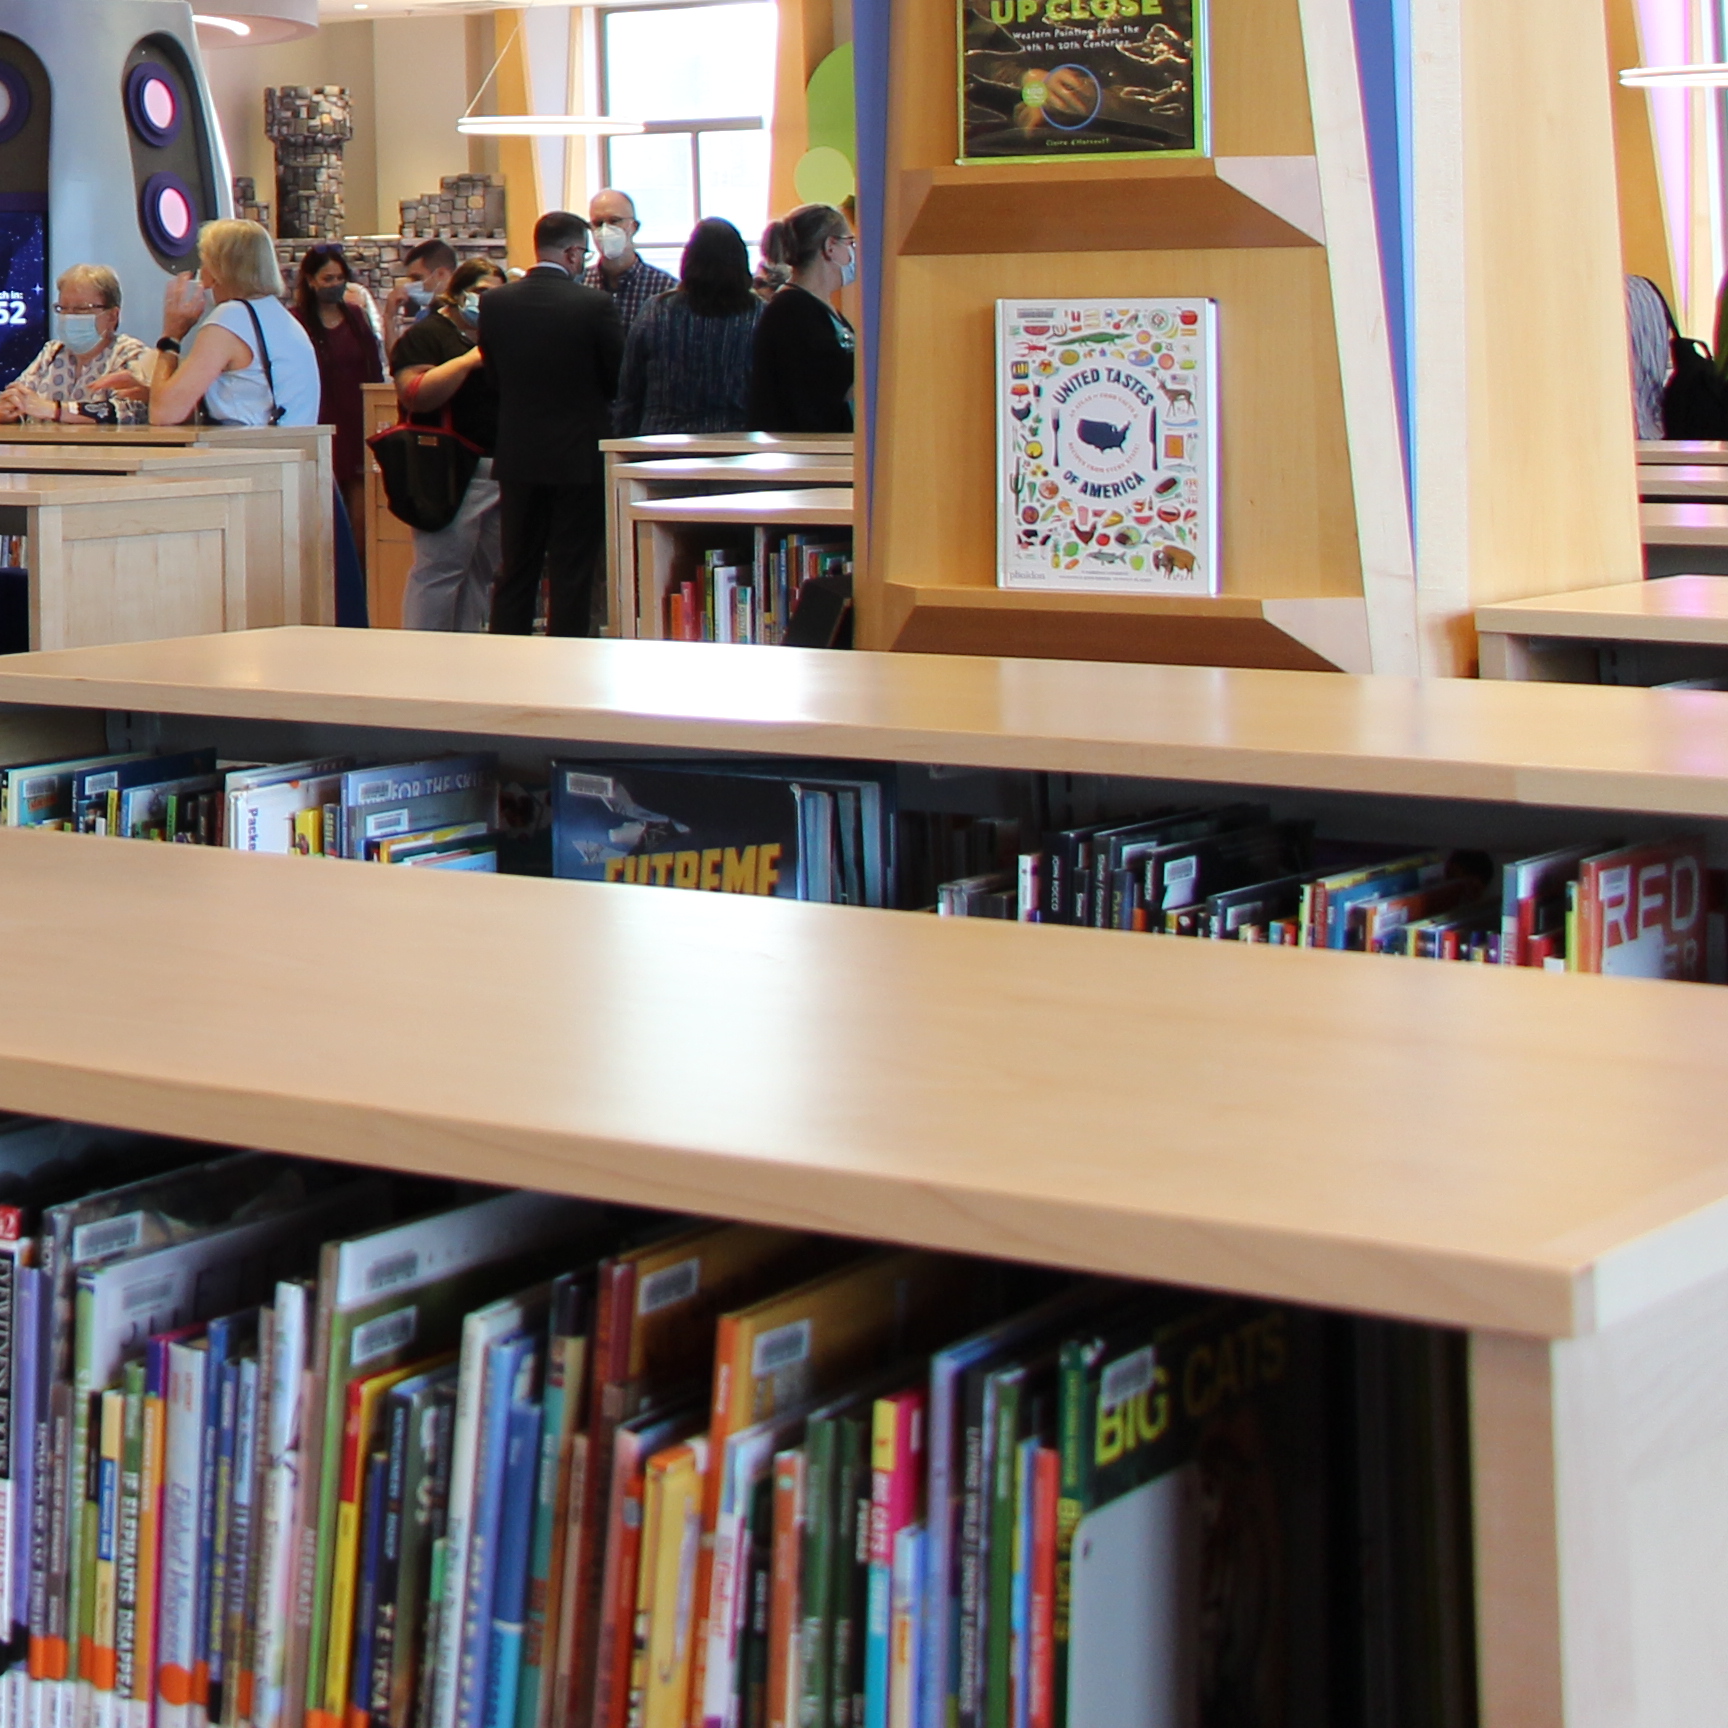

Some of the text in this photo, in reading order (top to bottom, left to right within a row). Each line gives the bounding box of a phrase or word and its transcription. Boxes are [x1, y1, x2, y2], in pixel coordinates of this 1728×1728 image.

[1012, 25, 1140, 40] Western Painting from the
[1045, 42, 1054, 51] to
[1058, 41, 1080, 50] 20th
[1046, 139, 1068, 147] Claire
[1052, 367, 1155, 406] UNITED TASTES
[1062, 469, 1146, 499] OF AMERICA
[425, 777, 451, 794] THE
[1051, 855, 1061, 911] JOHN ROCCO
[1602, 855, 1701, 947] RED
[1094, 1367, 1172, 1469] BIG
[114, 1471, 139, 1699] IF ELEPHANTS DISAPPEA
[295, 1527, 316, 1628] MEERKATS
